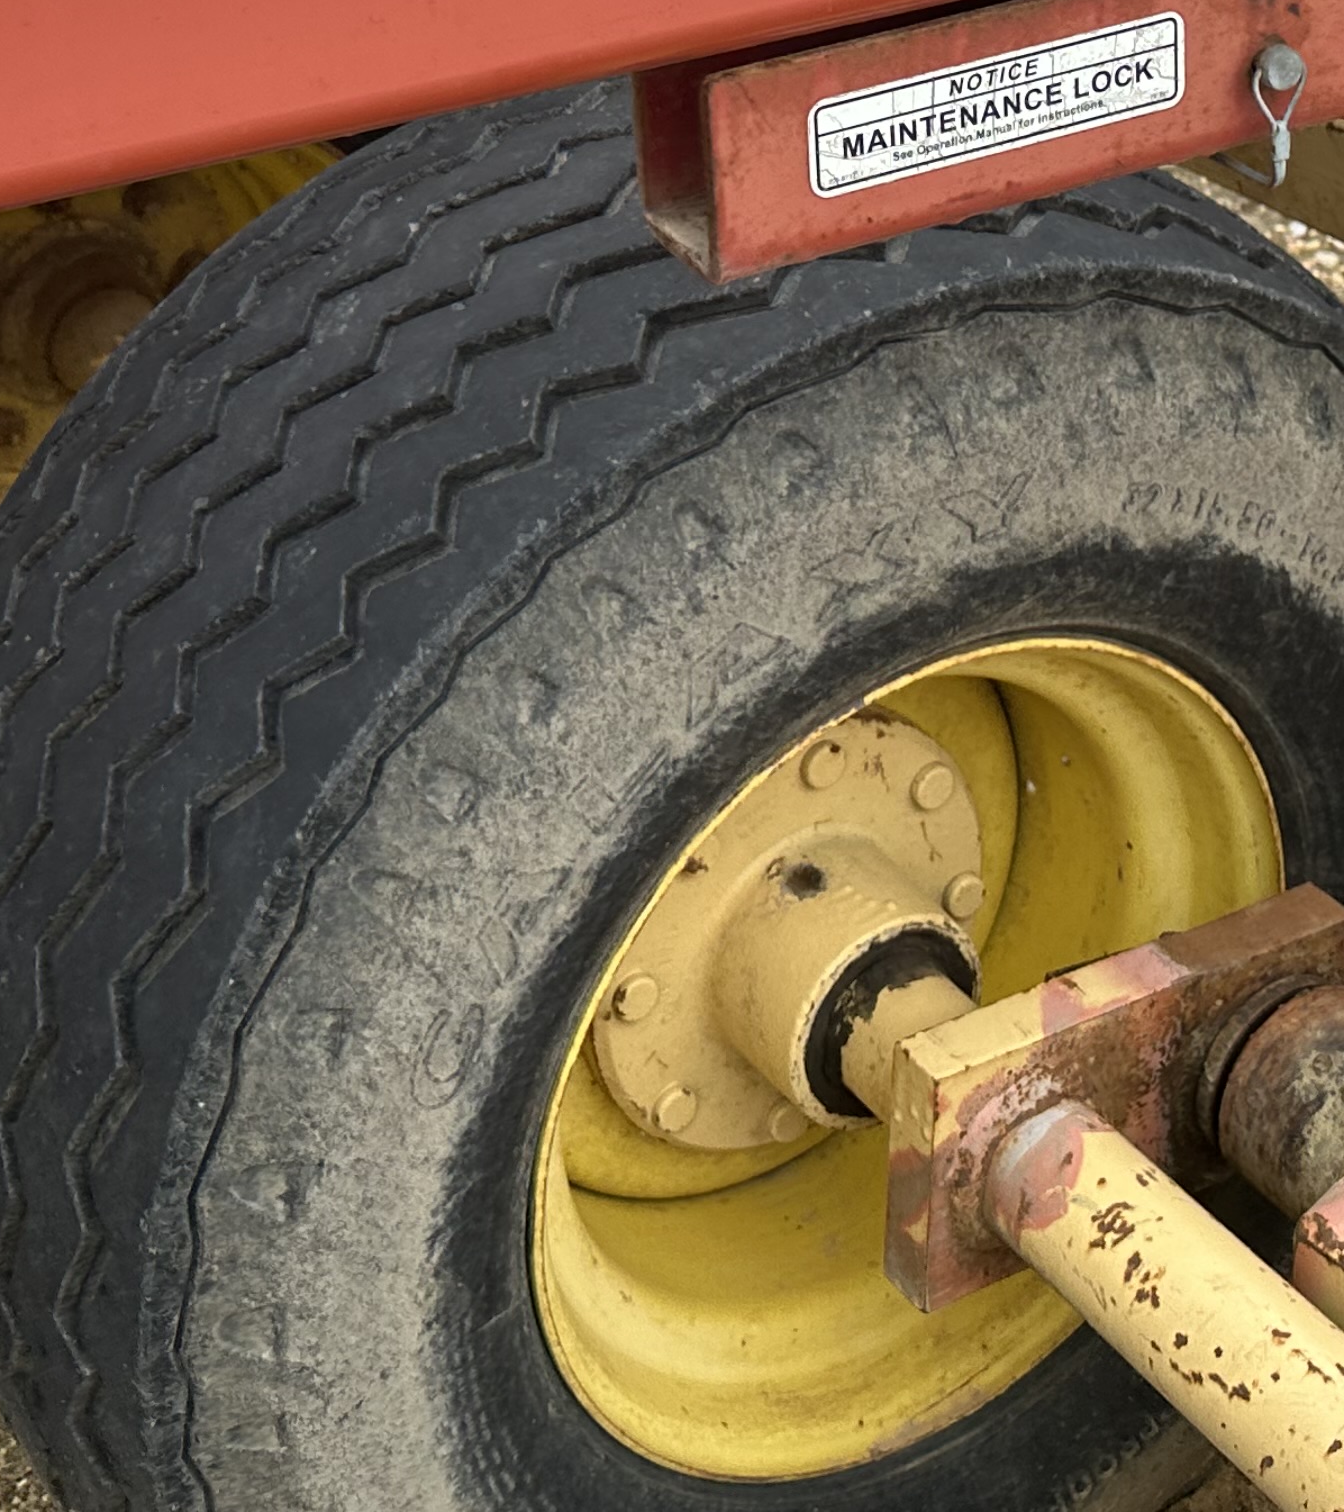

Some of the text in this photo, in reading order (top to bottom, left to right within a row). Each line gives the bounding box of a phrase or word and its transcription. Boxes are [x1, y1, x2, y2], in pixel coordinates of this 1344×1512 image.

[949, 58, 1039, 97] NOTICE
[842, 58, 1154, 159] MAINTENANCE LOCK
[892, 149, 914, 162] See
[976, 119, 1017, 140] Manual
[1018, 117, 1035, 128] for
